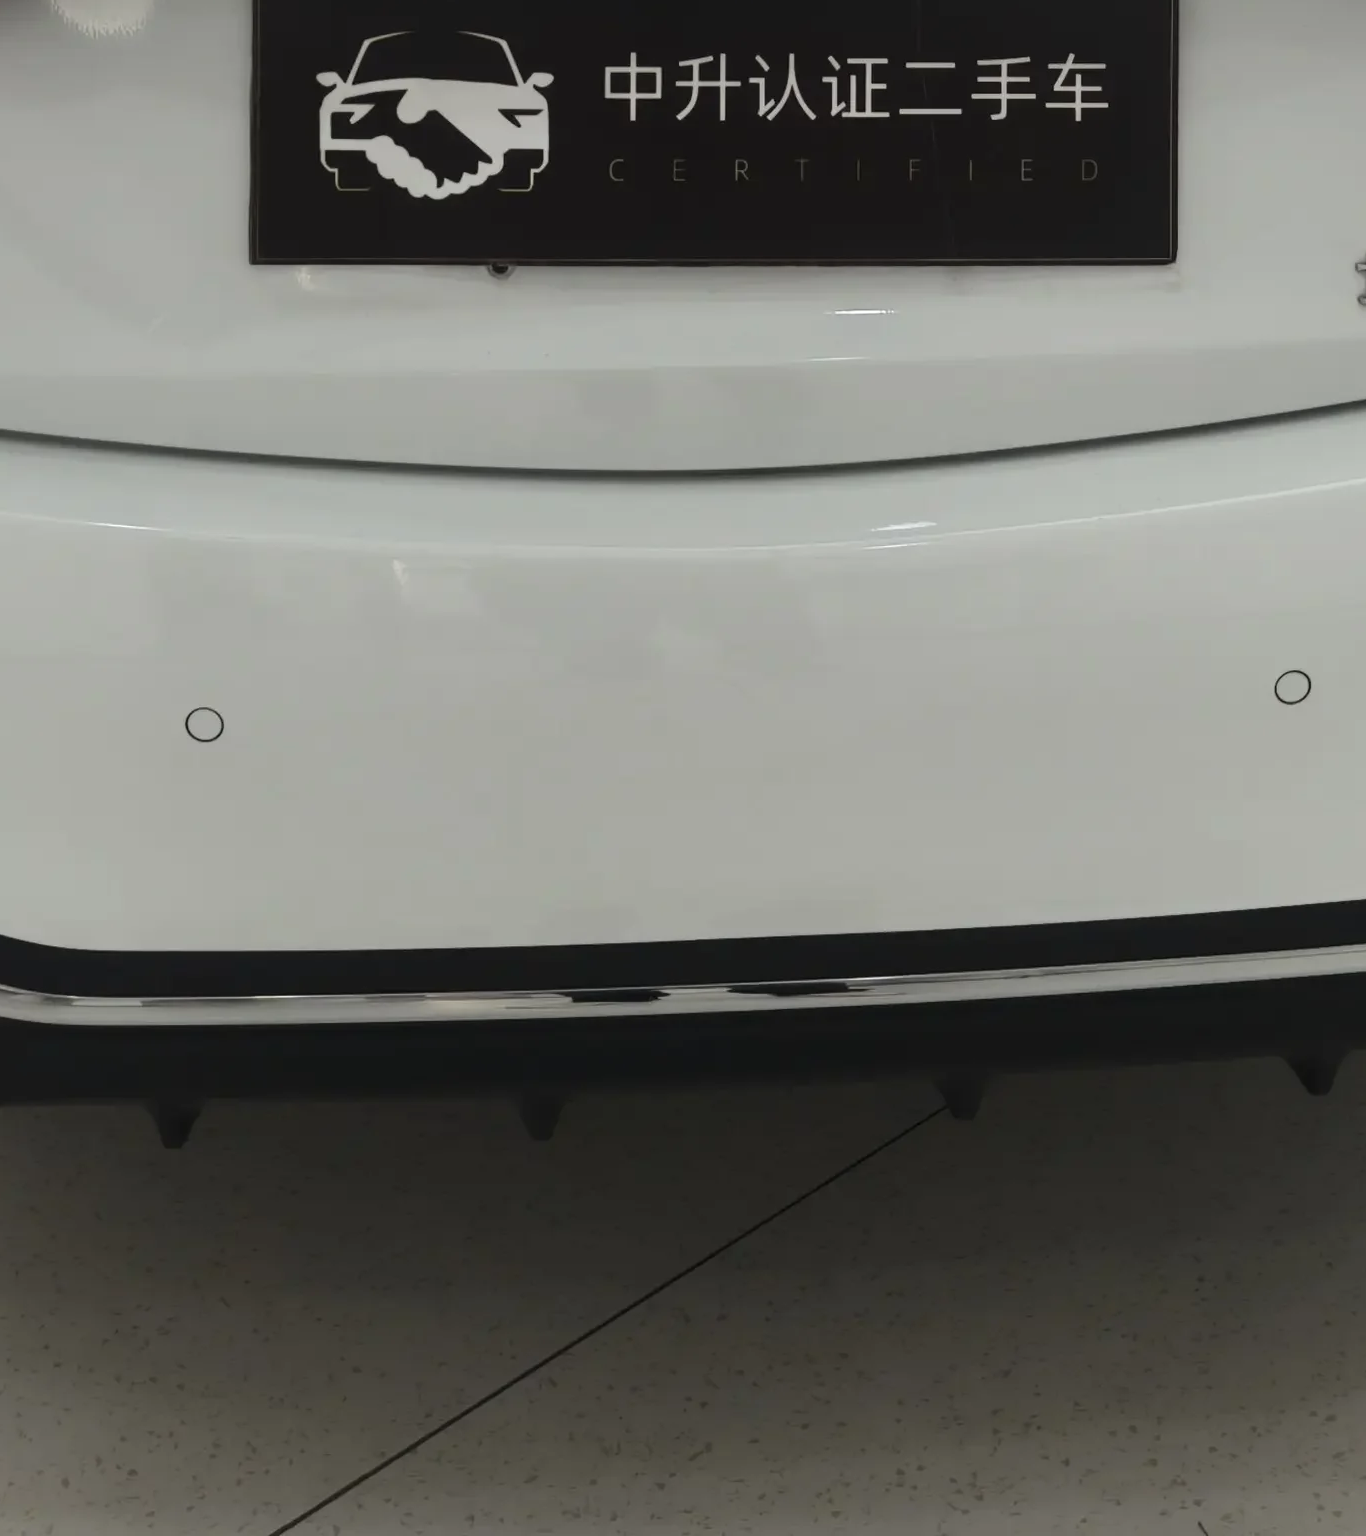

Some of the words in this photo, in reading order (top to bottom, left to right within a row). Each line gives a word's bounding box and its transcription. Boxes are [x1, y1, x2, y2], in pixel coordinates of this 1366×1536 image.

[604, 52, 1109, 122] 中升认证二手车
[608, 159, 1099, 182] CERTIFIED
